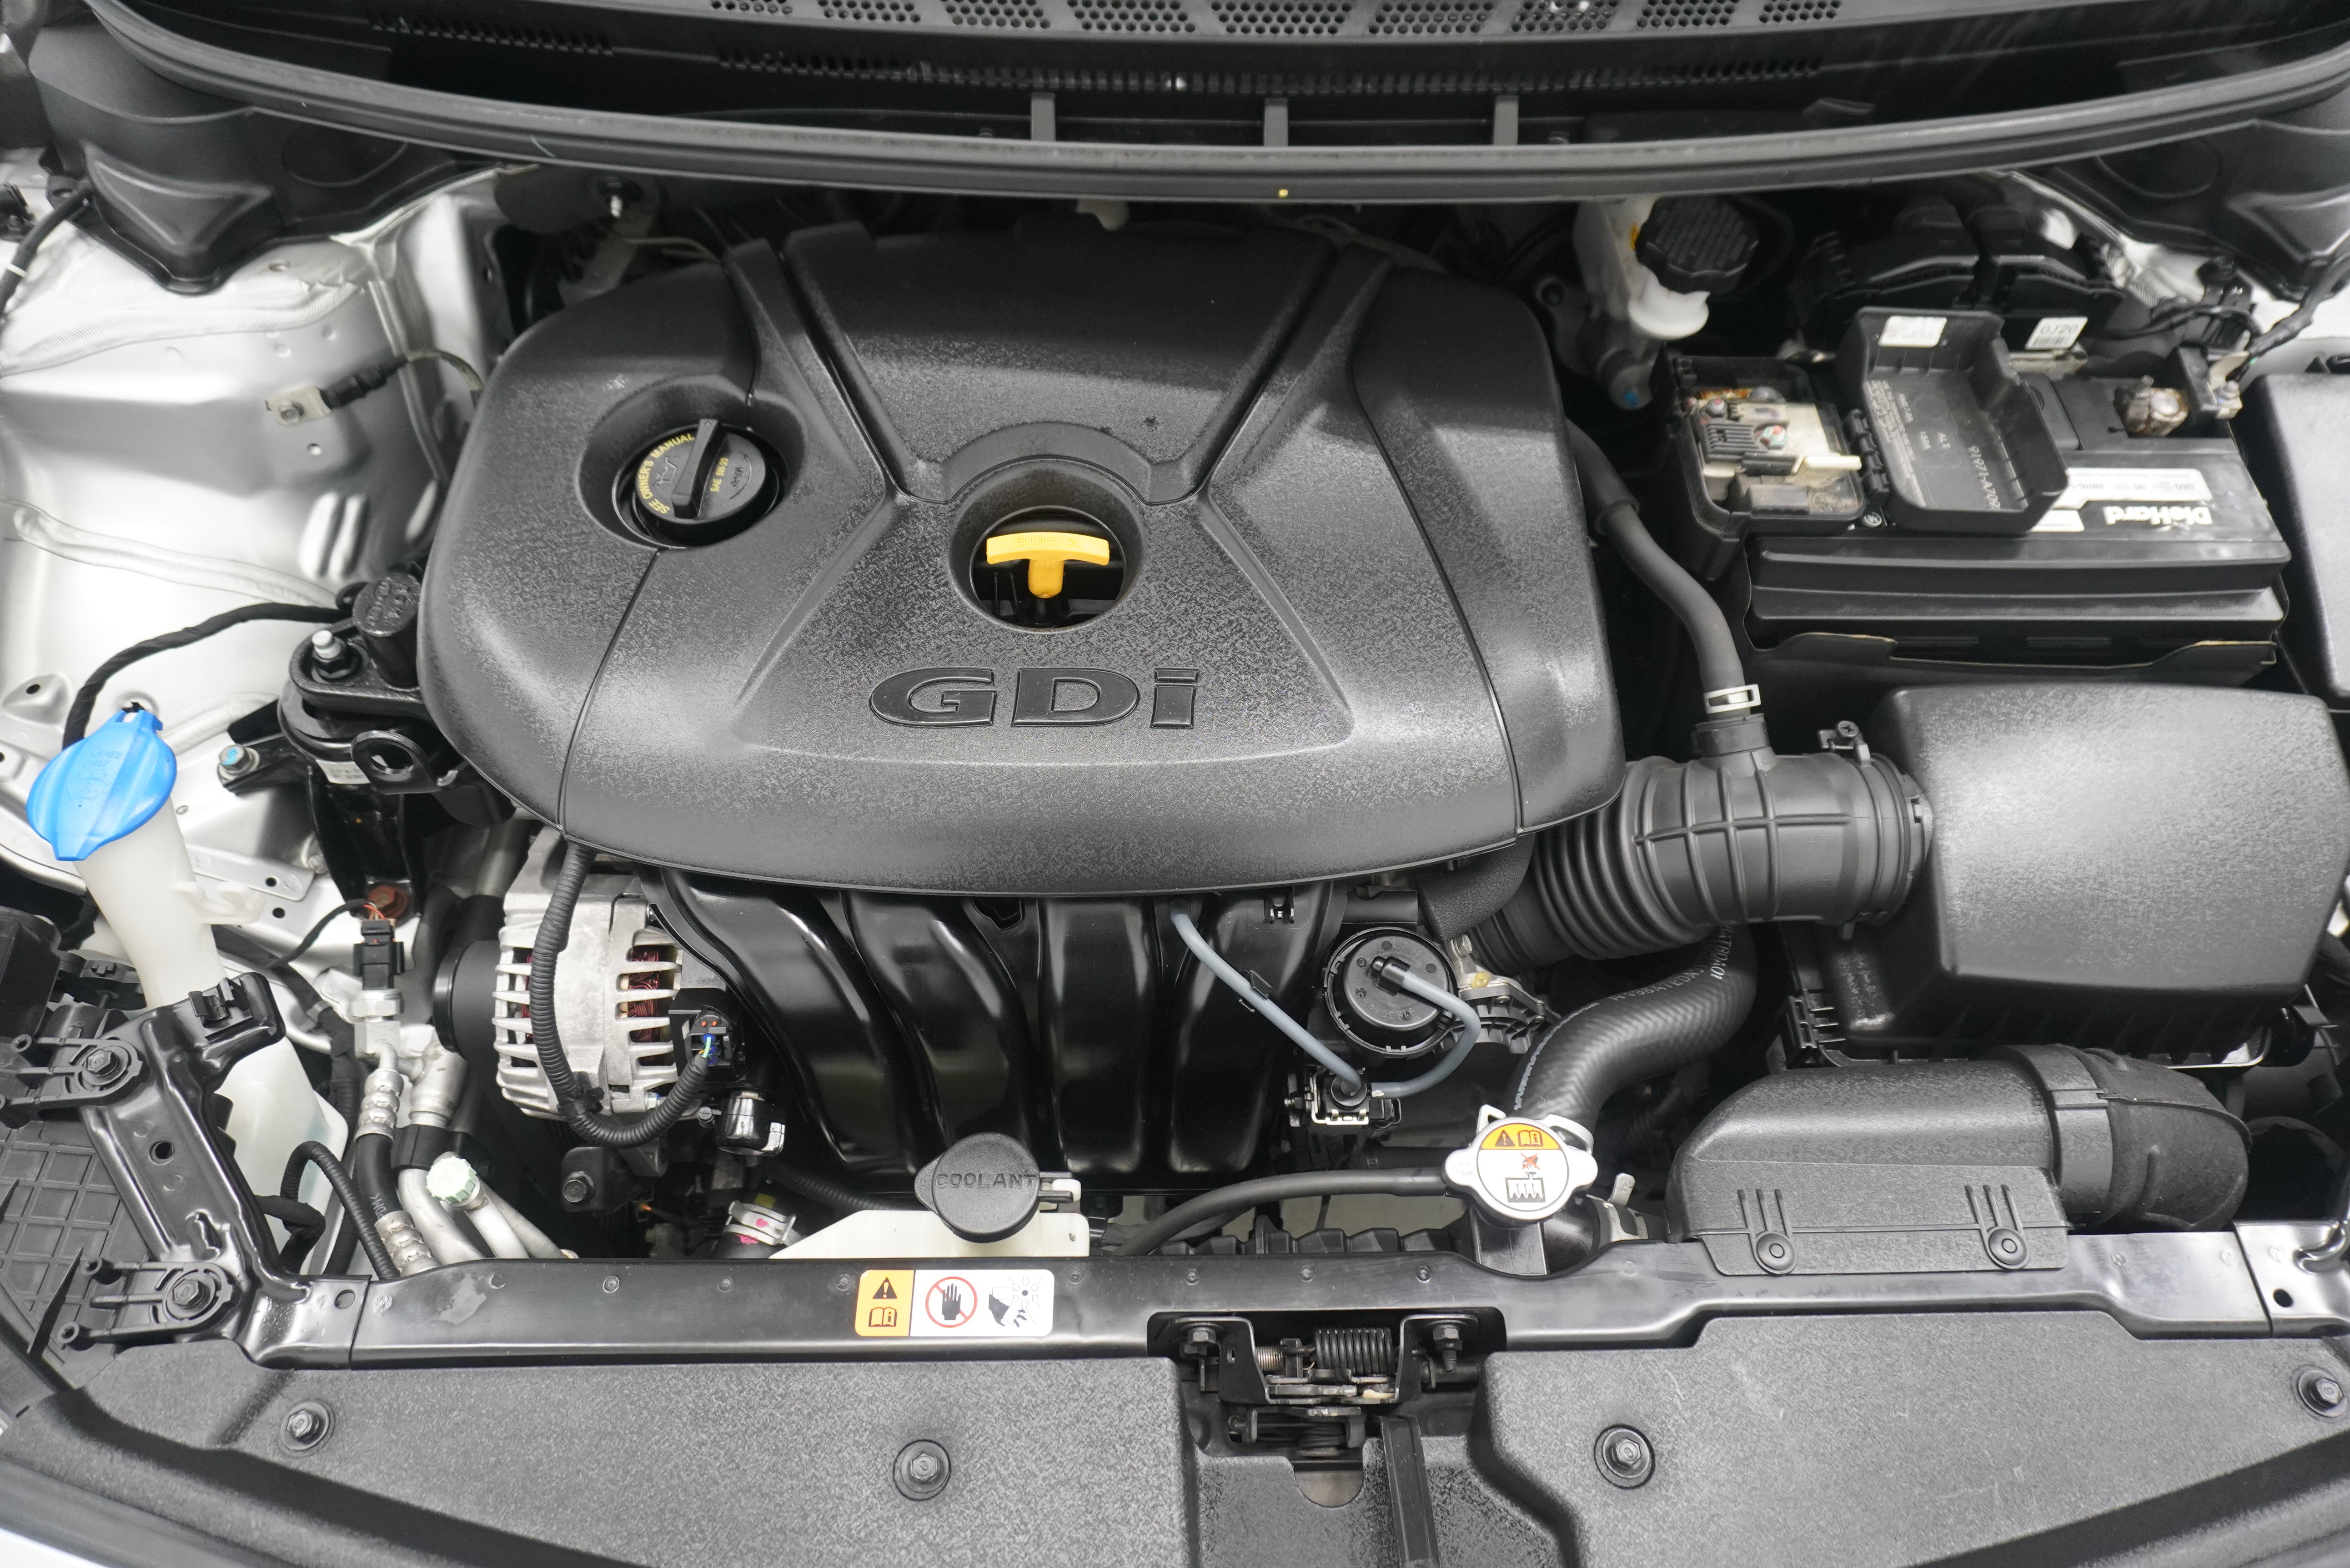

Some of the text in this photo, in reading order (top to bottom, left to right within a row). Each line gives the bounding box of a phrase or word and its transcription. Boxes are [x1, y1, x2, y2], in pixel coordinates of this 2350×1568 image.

[1938, 432, 1951, 449] ALT
[638, 433, 695, 514] SEE OWNER'S MANUAL
[1968, 445, 2001, 510] 91971-A709
[710, 478, 722, 492] SAE
[2103, 505, 2213, 525] DieHard
[1016, 535, 1081, 548] ENGINE OIL
[869, 667, 1200, 729] GDi
[935, 1172, 1036, 1189] COOLANT
